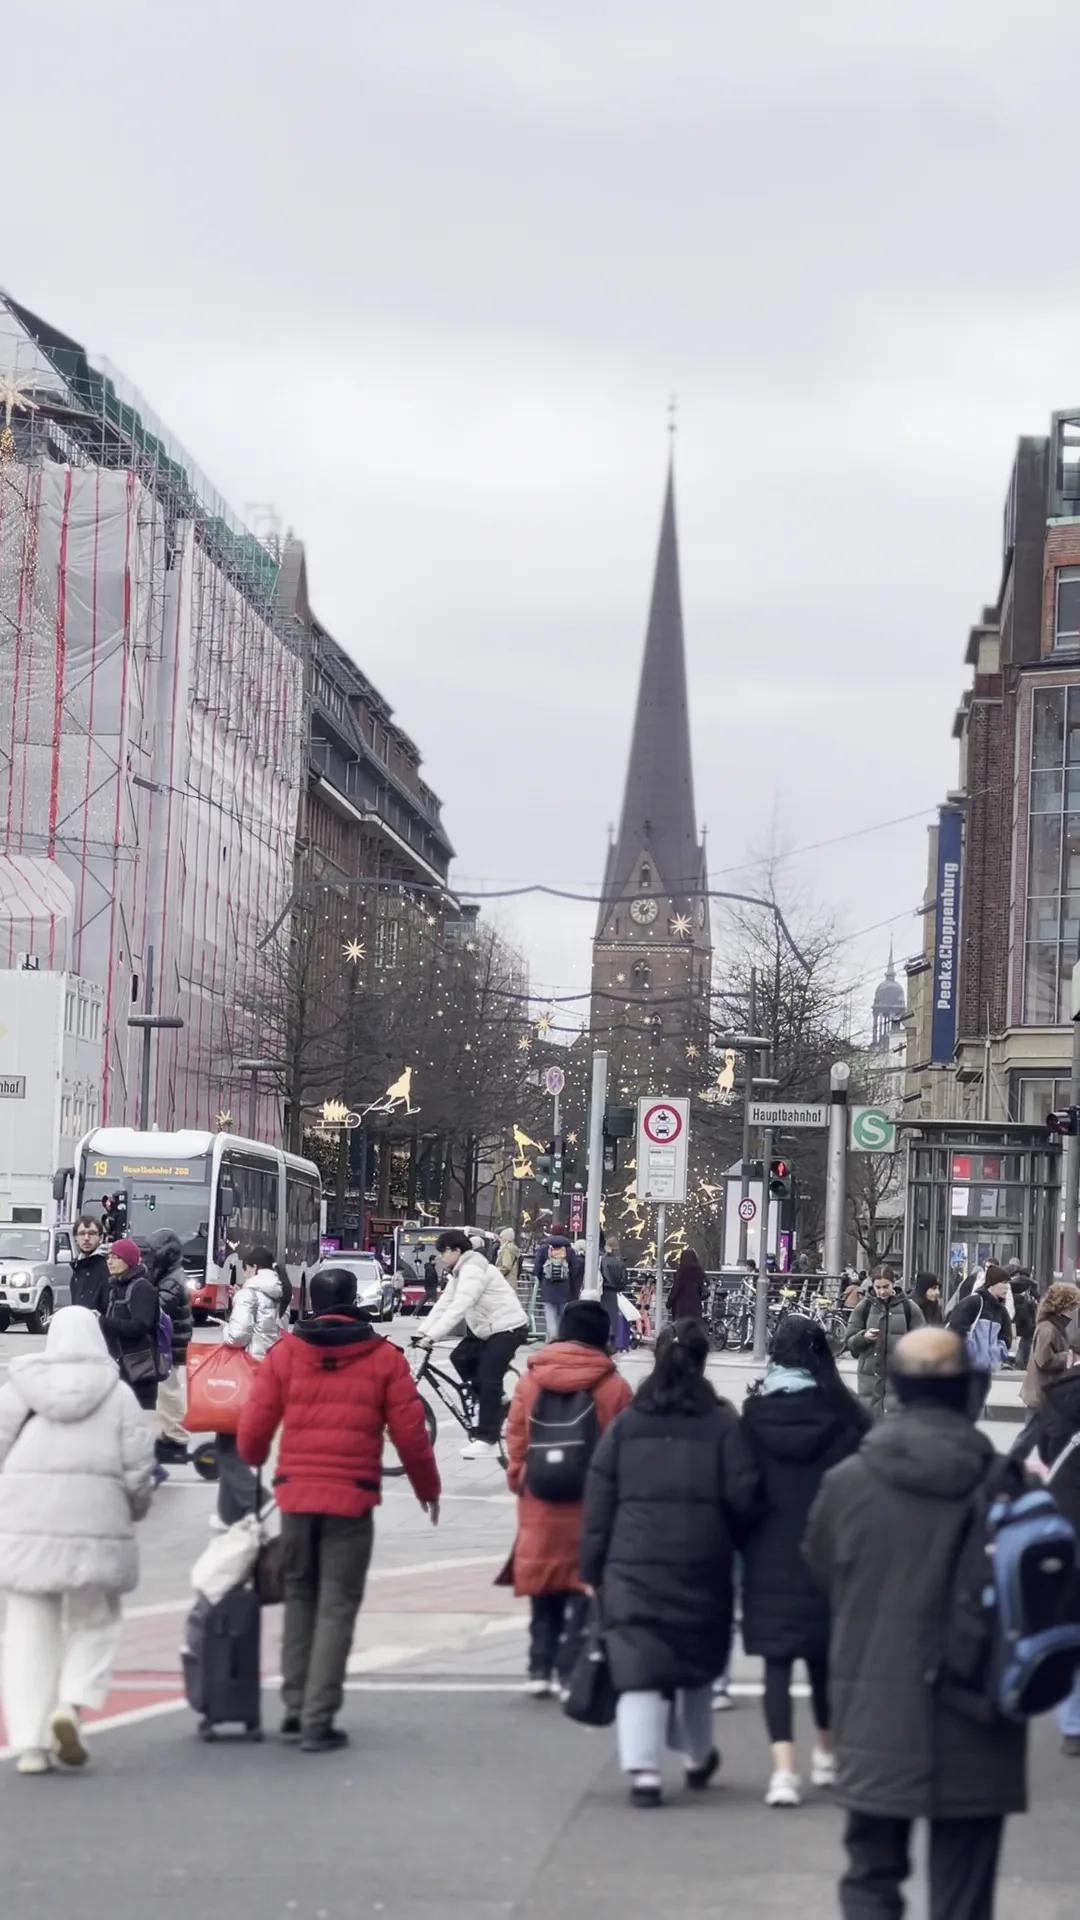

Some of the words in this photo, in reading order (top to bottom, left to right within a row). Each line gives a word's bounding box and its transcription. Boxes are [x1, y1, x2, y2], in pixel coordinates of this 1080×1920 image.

[752, 1107, 822, 1123] Hauptbahnhof
[861, 1114, 886, 1145] S
[93, 1160, 108, 1176] 19
[742, 1204, 753, 1216] 25
